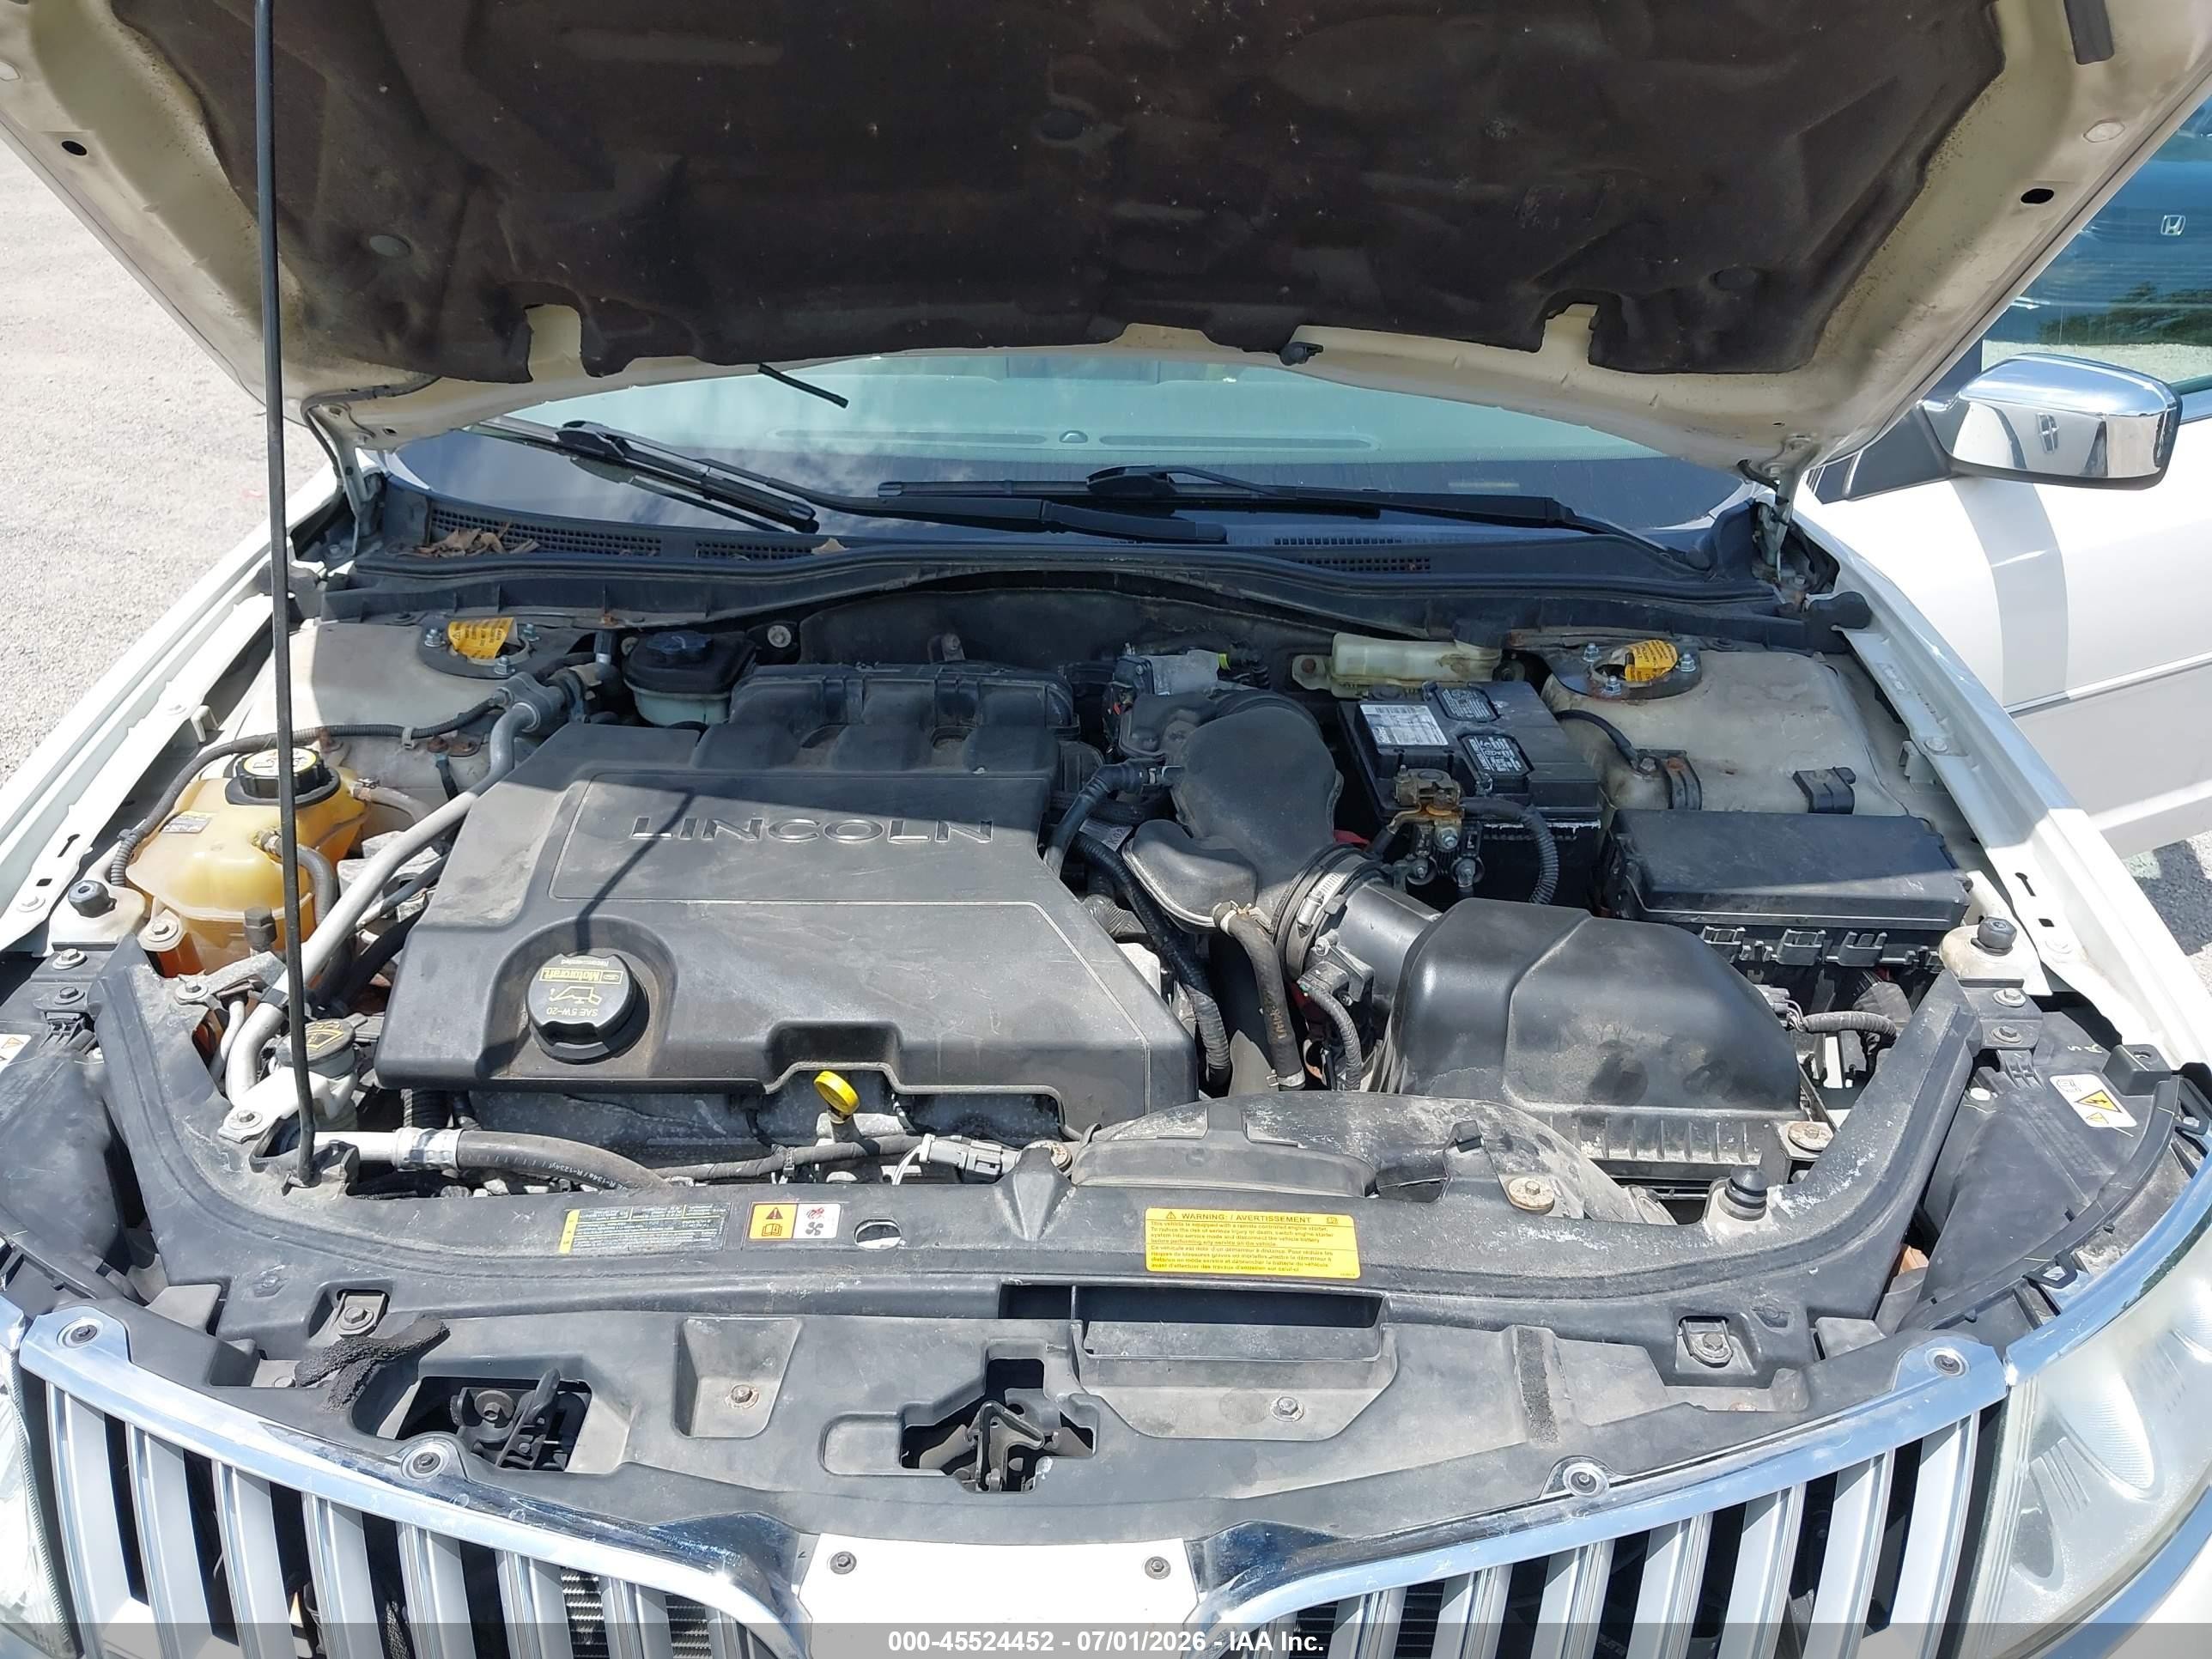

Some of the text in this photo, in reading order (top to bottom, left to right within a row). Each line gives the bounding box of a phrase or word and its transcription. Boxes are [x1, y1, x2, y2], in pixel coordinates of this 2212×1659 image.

[630, 816, 994, 845] LINCOLN
[544, 969, 600, 981] Motorcraft
[546, 1007, 599, 1018] SAE 5W-20
[1236, 1214, 1312, 1224] AVERTISSEMENT
